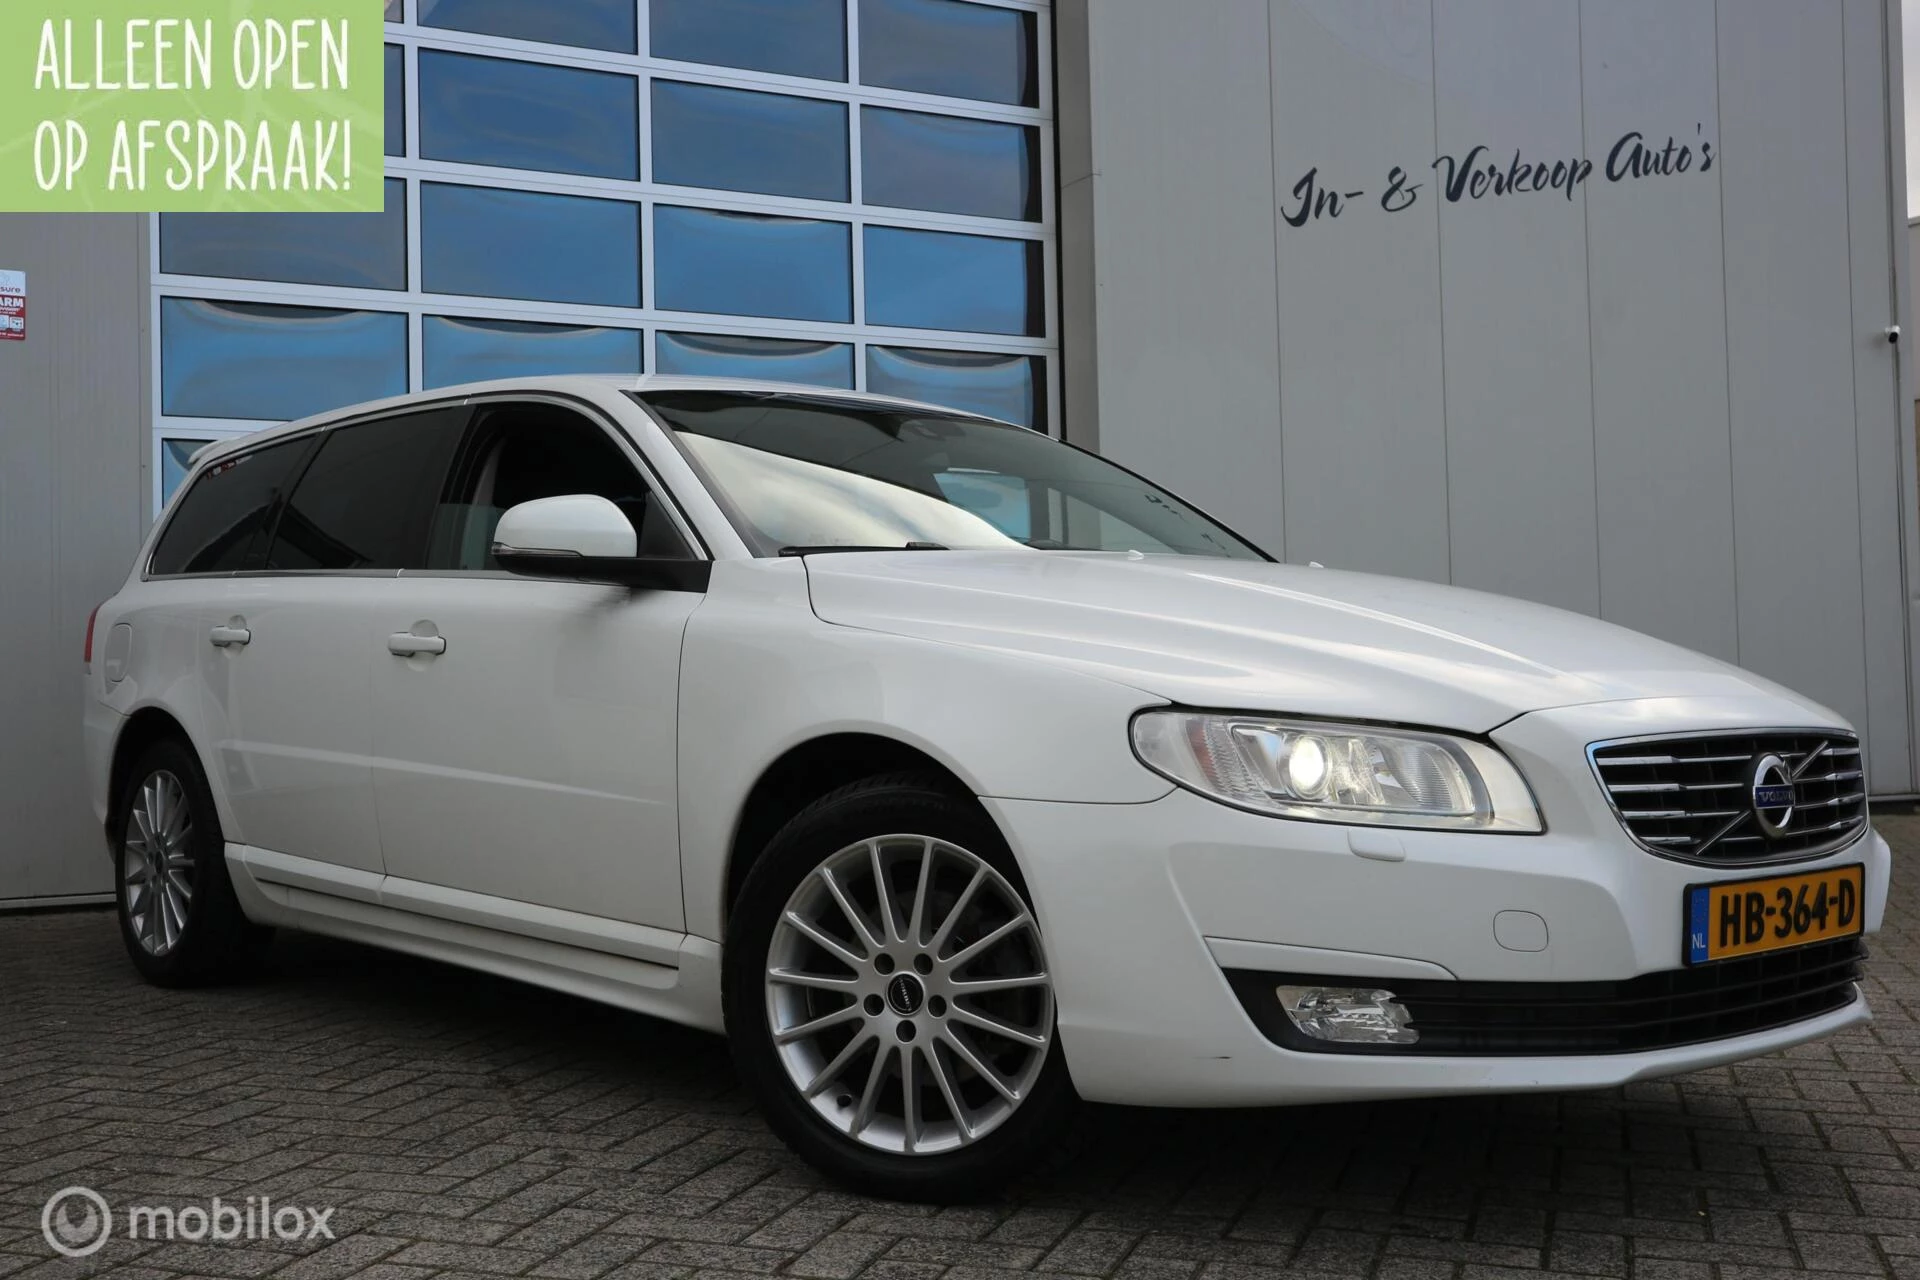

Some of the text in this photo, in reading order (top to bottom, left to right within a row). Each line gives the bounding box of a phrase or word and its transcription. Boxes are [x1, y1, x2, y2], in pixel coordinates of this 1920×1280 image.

[1280, 122, 1717, 227] In- & Verkoop Auto's
[1691, 933, 1706, 949] NL
[1719, 878, 1856, 948] HB-364-D
